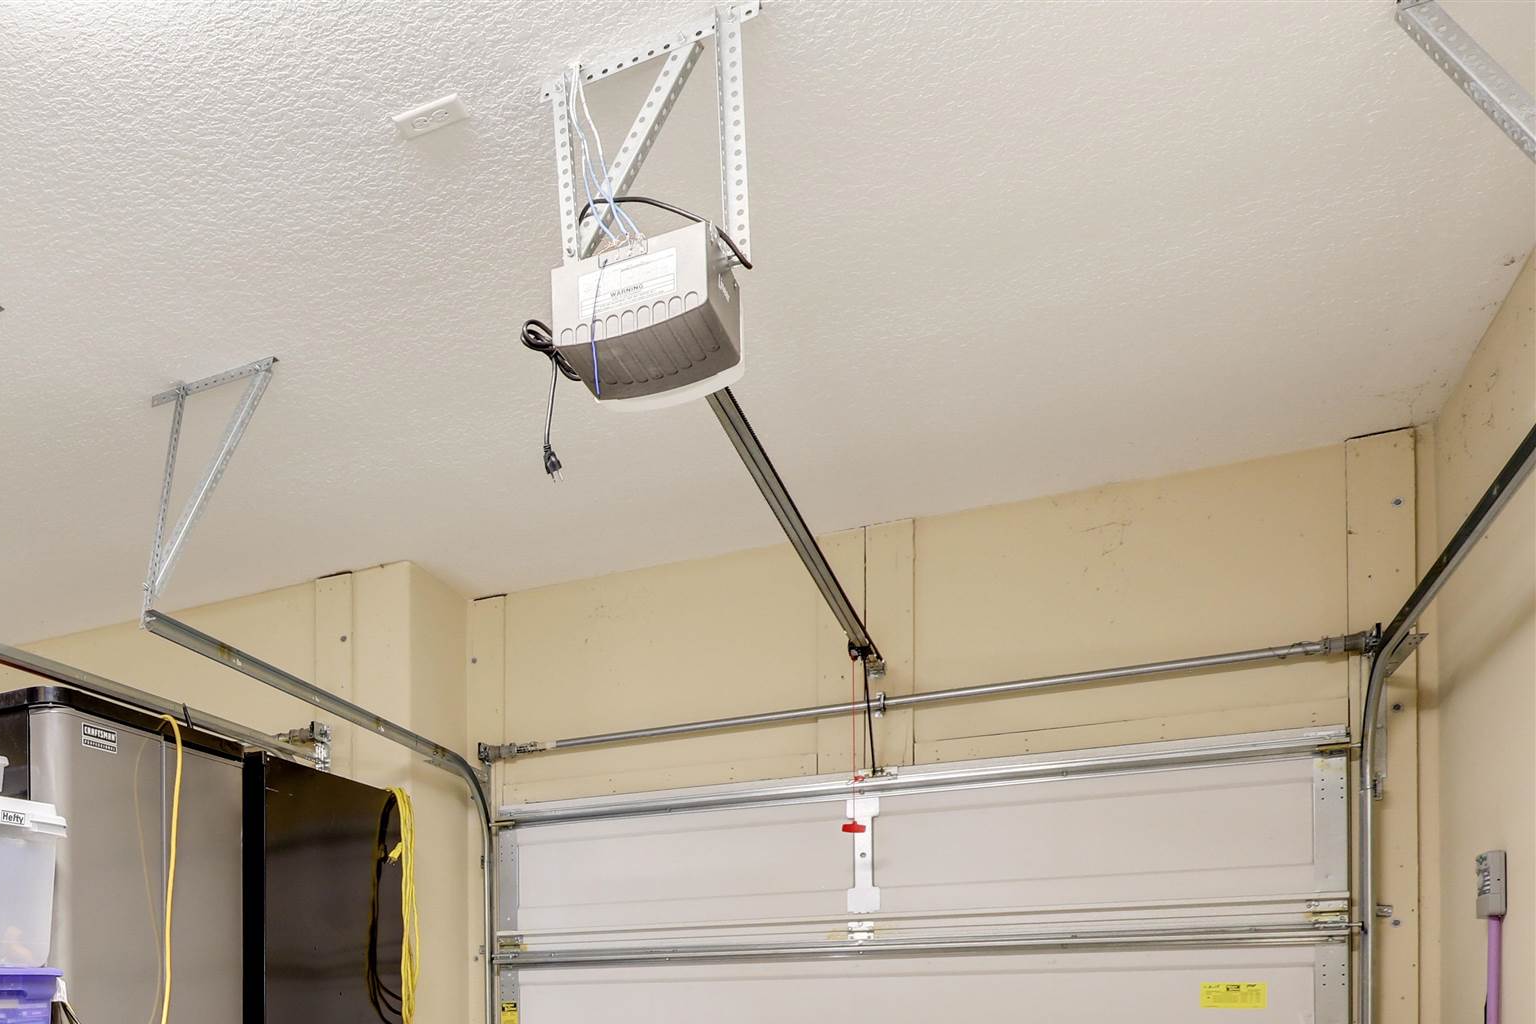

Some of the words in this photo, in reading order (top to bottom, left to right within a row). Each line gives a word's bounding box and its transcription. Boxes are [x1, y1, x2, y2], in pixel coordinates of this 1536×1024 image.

[610, 282, 644, 298] WARNING
[84, 726, 116, 741] CRAFTSMAN
[2, 811, 24, 825] Hefty
